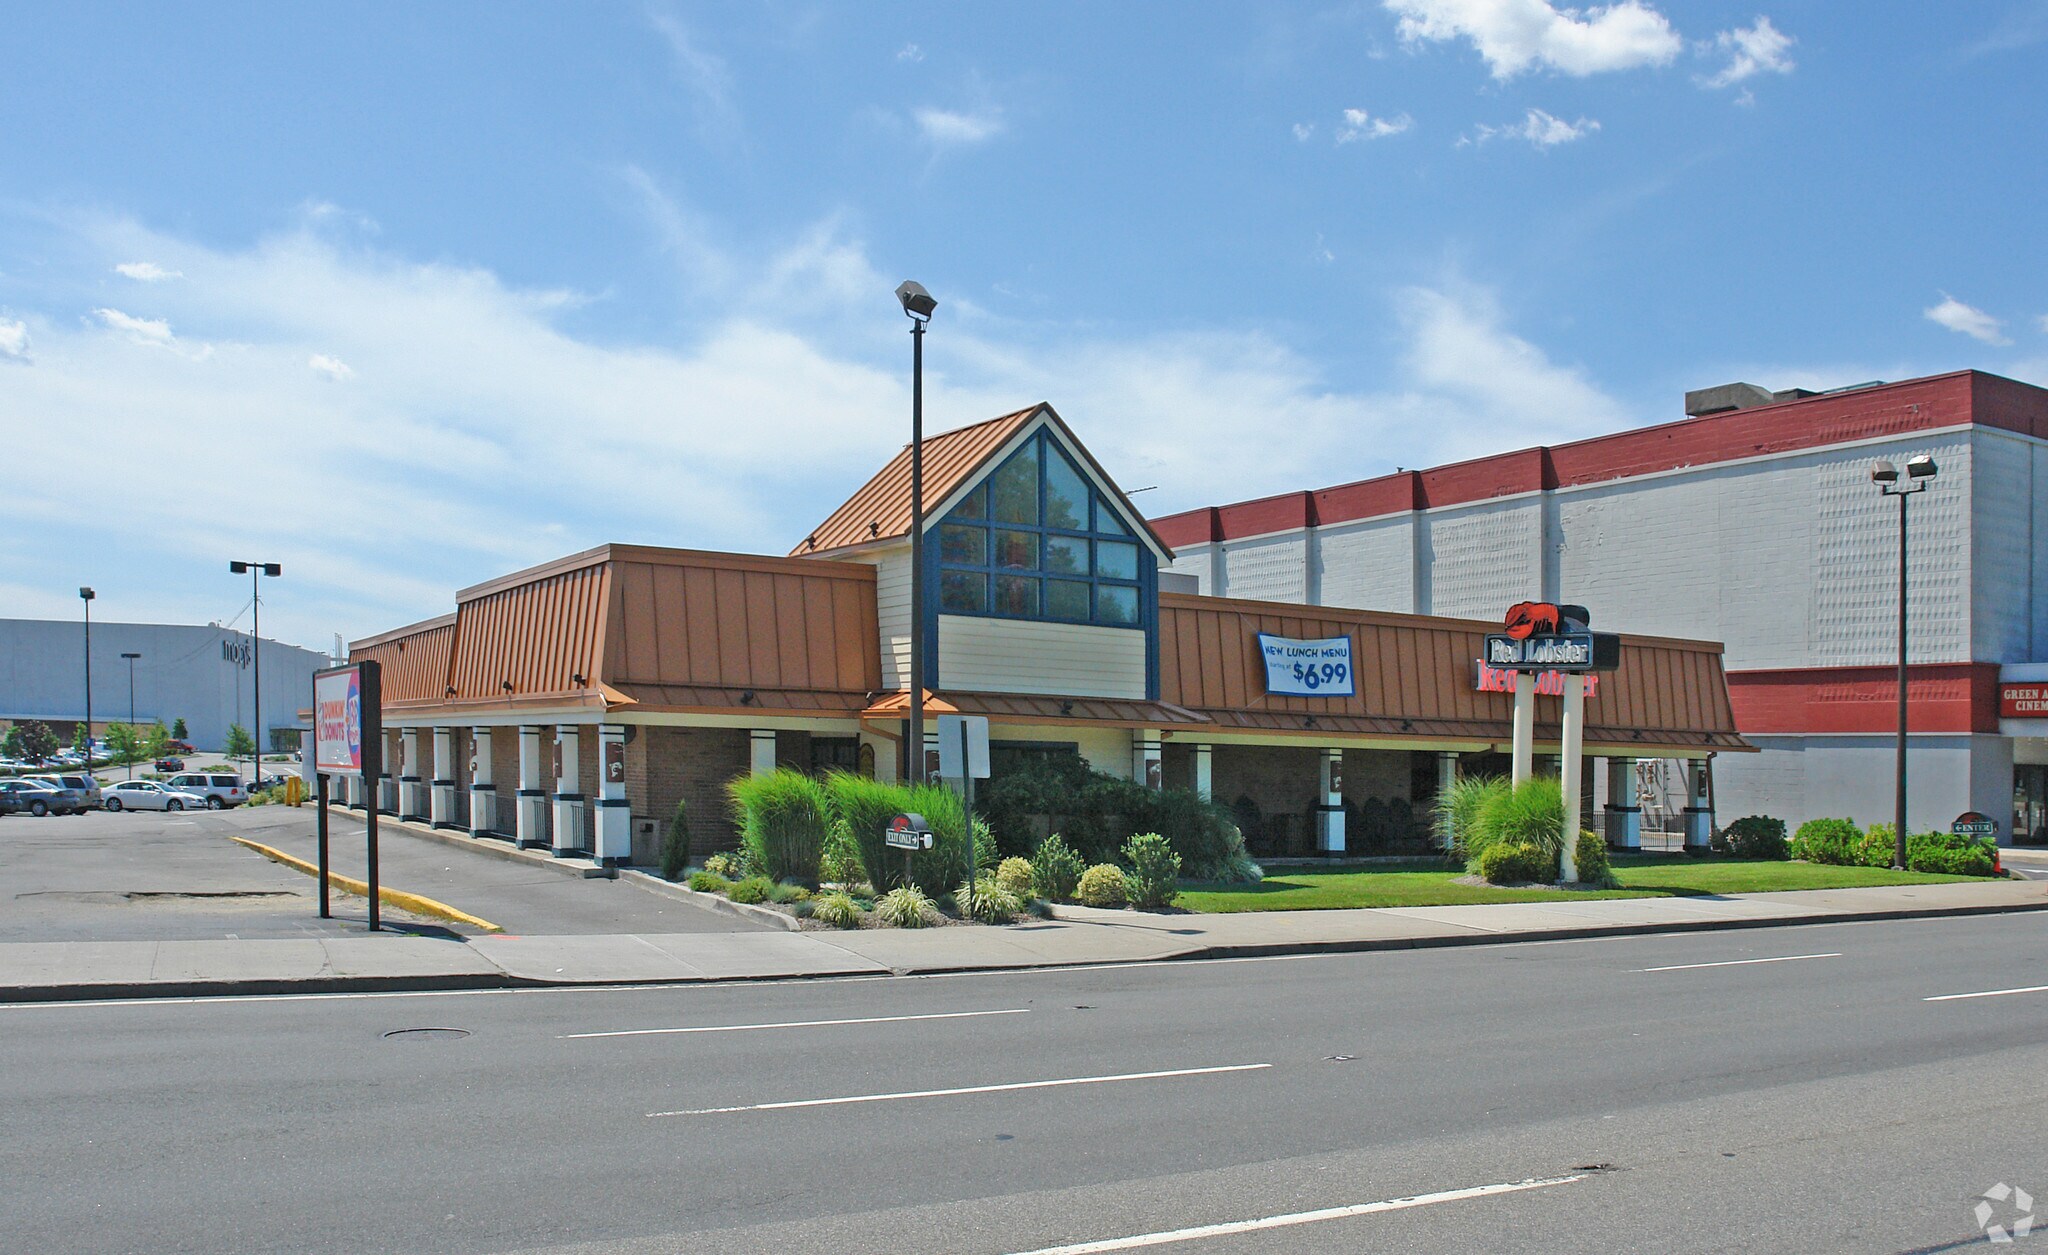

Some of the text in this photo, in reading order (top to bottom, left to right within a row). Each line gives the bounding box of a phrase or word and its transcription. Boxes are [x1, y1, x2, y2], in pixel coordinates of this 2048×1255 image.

[1265, 646, 1347, 658] NEW LUNCH MENU
[1489, 638, 1588, 663] Red Lobster
[1293, 660, 1347, 689] $6.99
[2003, 689, 2039, 700] GREEN
[325, 721, 345, 741] DONUTS
[1962, 823, 1990, 831] ENTER
[887, 832, 912, 844] EXIT ONLY
